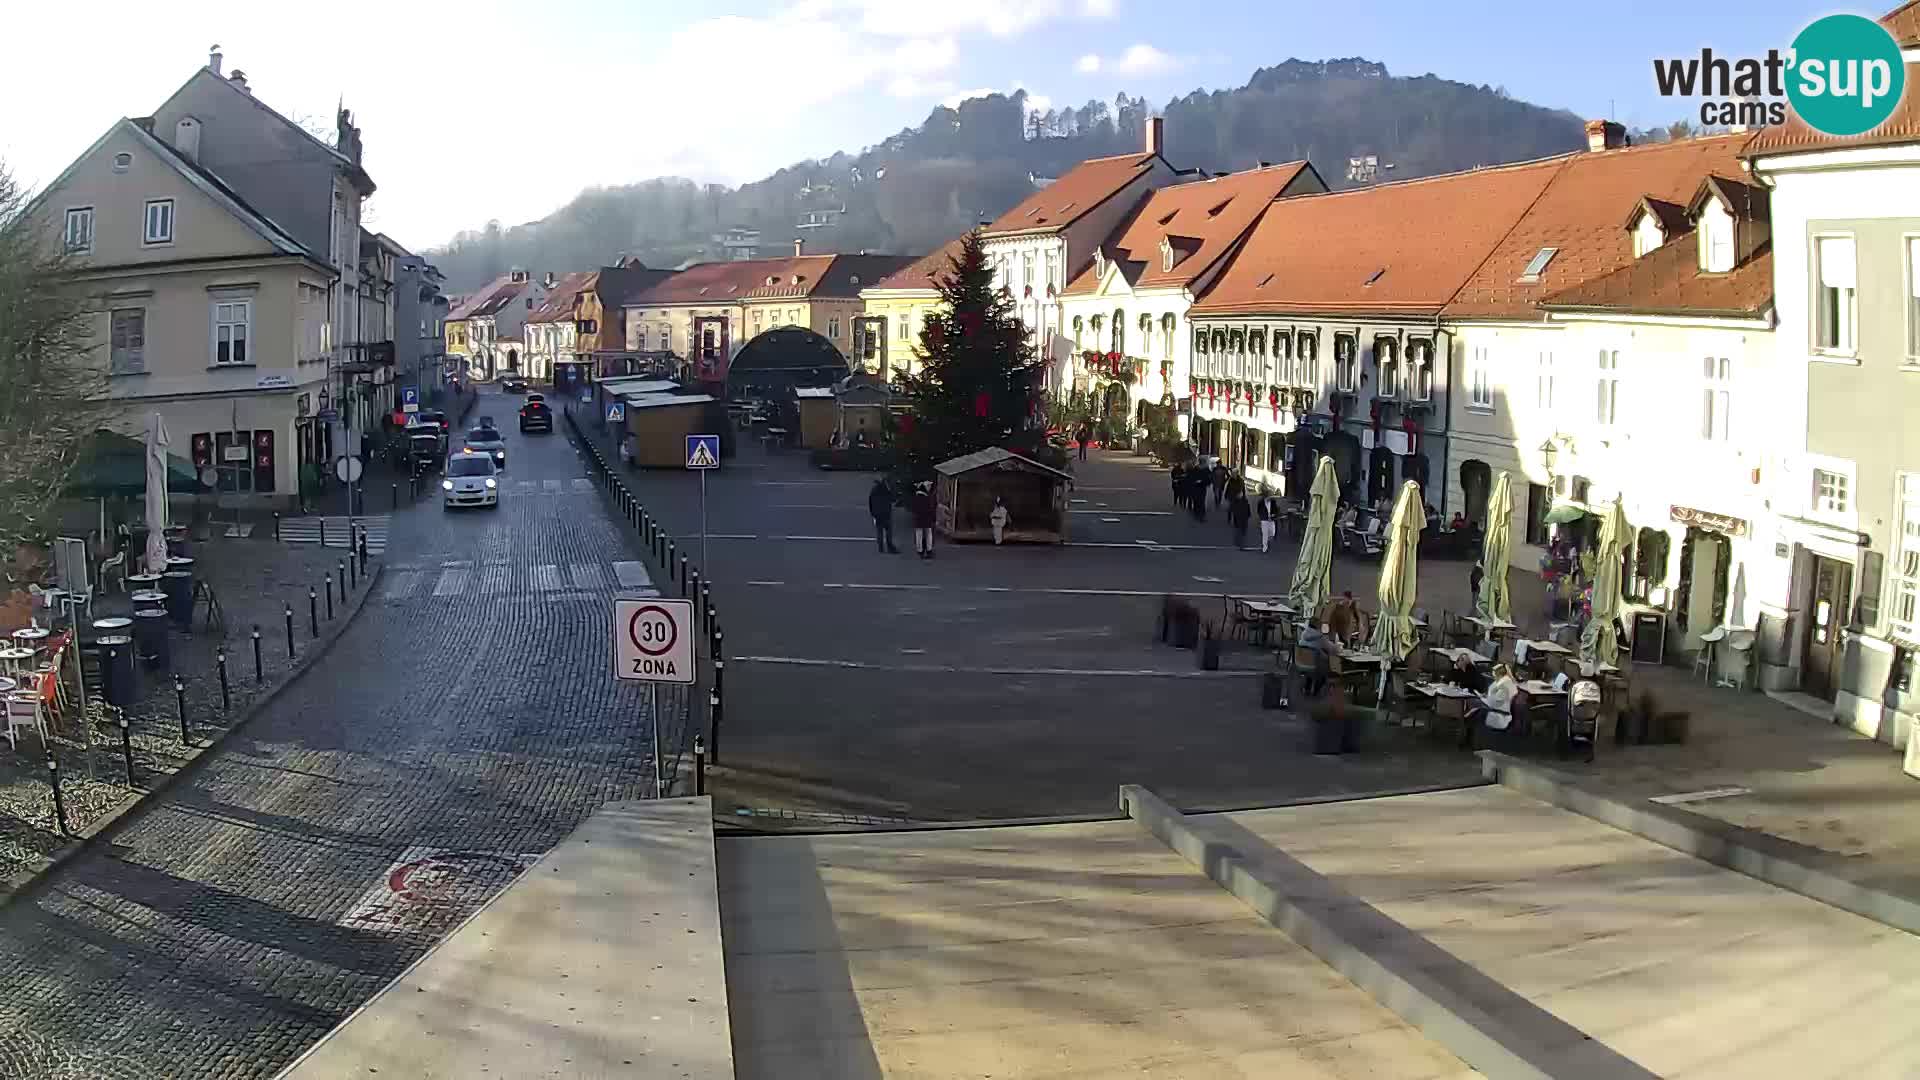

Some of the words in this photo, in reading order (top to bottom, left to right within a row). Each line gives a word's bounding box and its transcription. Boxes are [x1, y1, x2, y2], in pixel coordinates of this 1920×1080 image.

[406, 390, 415, 402] P
[642, 621, 666, 643] 30
[632, 658, 677, 676] ZONA
